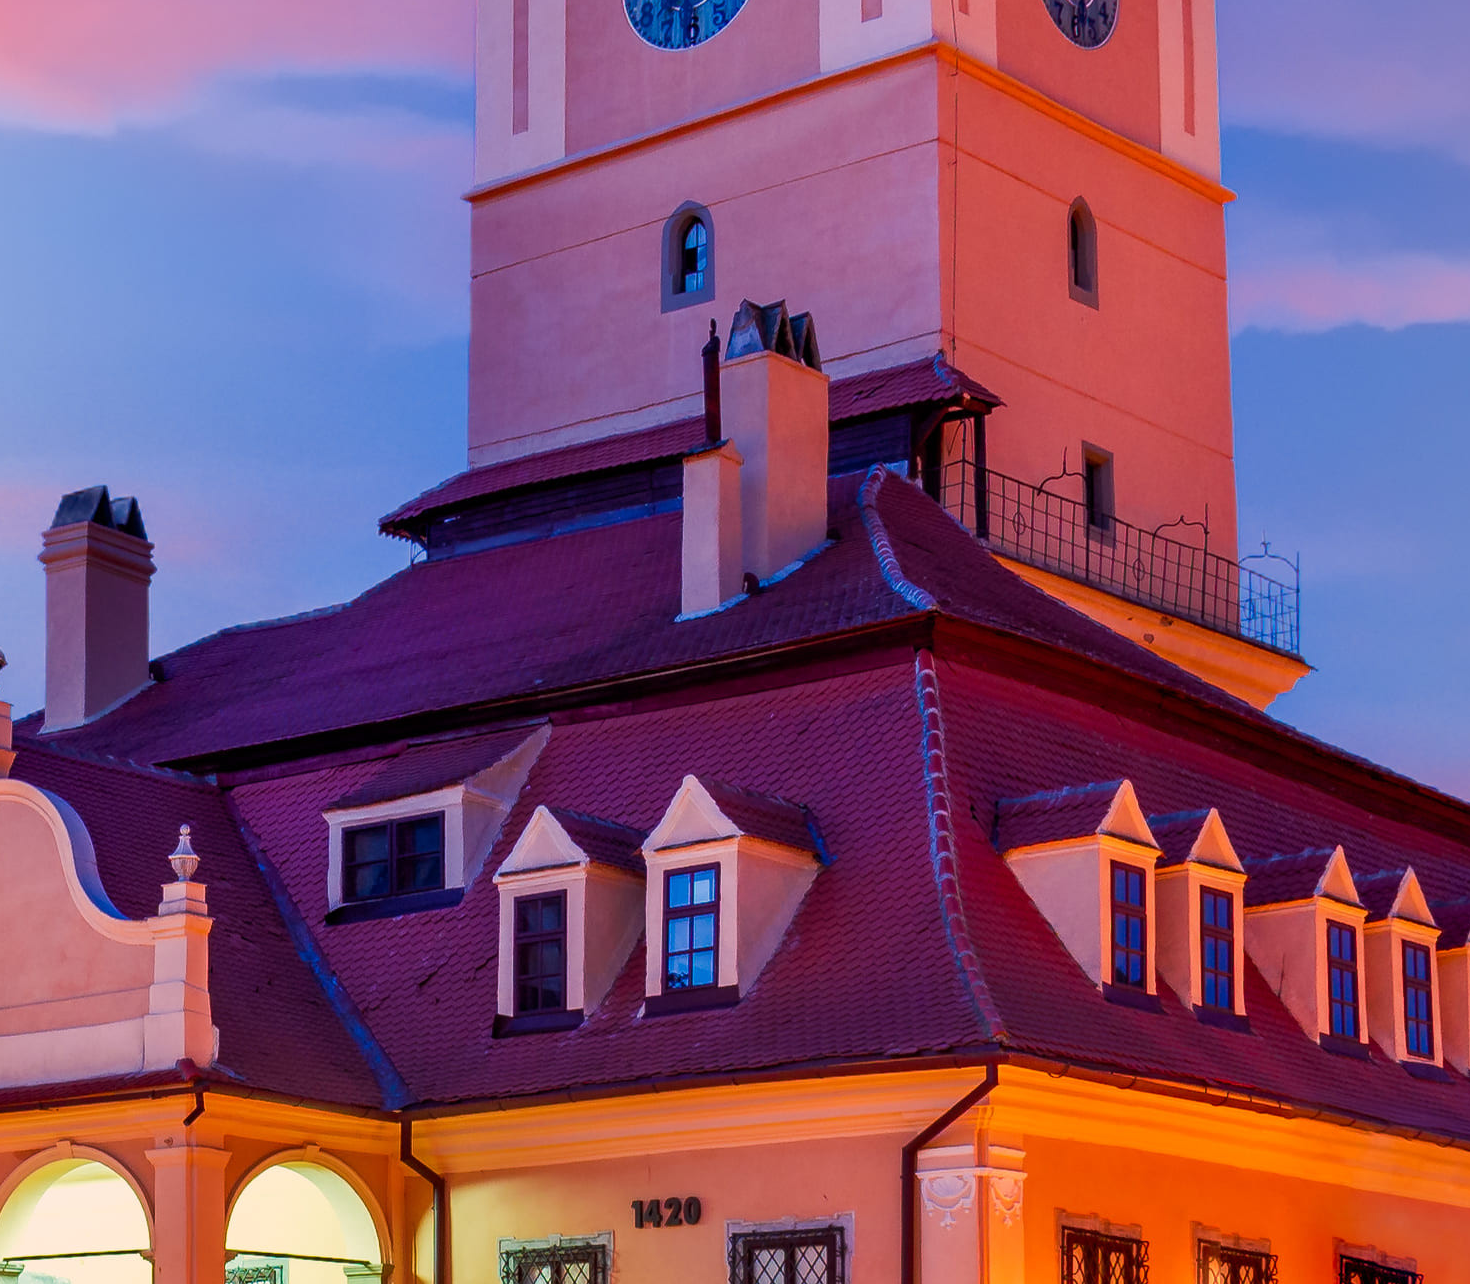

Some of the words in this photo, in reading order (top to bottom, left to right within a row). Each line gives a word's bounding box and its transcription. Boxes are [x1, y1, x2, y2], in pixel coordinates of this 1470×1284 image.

[640, 2, 654, 28] 8
[713, 0, 726, 26] 5
[1054, 0, 1064, 26] 7
[1071, 14, 1080, 38] 6
[1099, 1, 1108, 25] 4
[661, 19, 674, 43] 7
[687, 15, 700, 41] 6
[1088, 18, 1096, 40] 5
[631, 1196, 702, 1228] 1420
